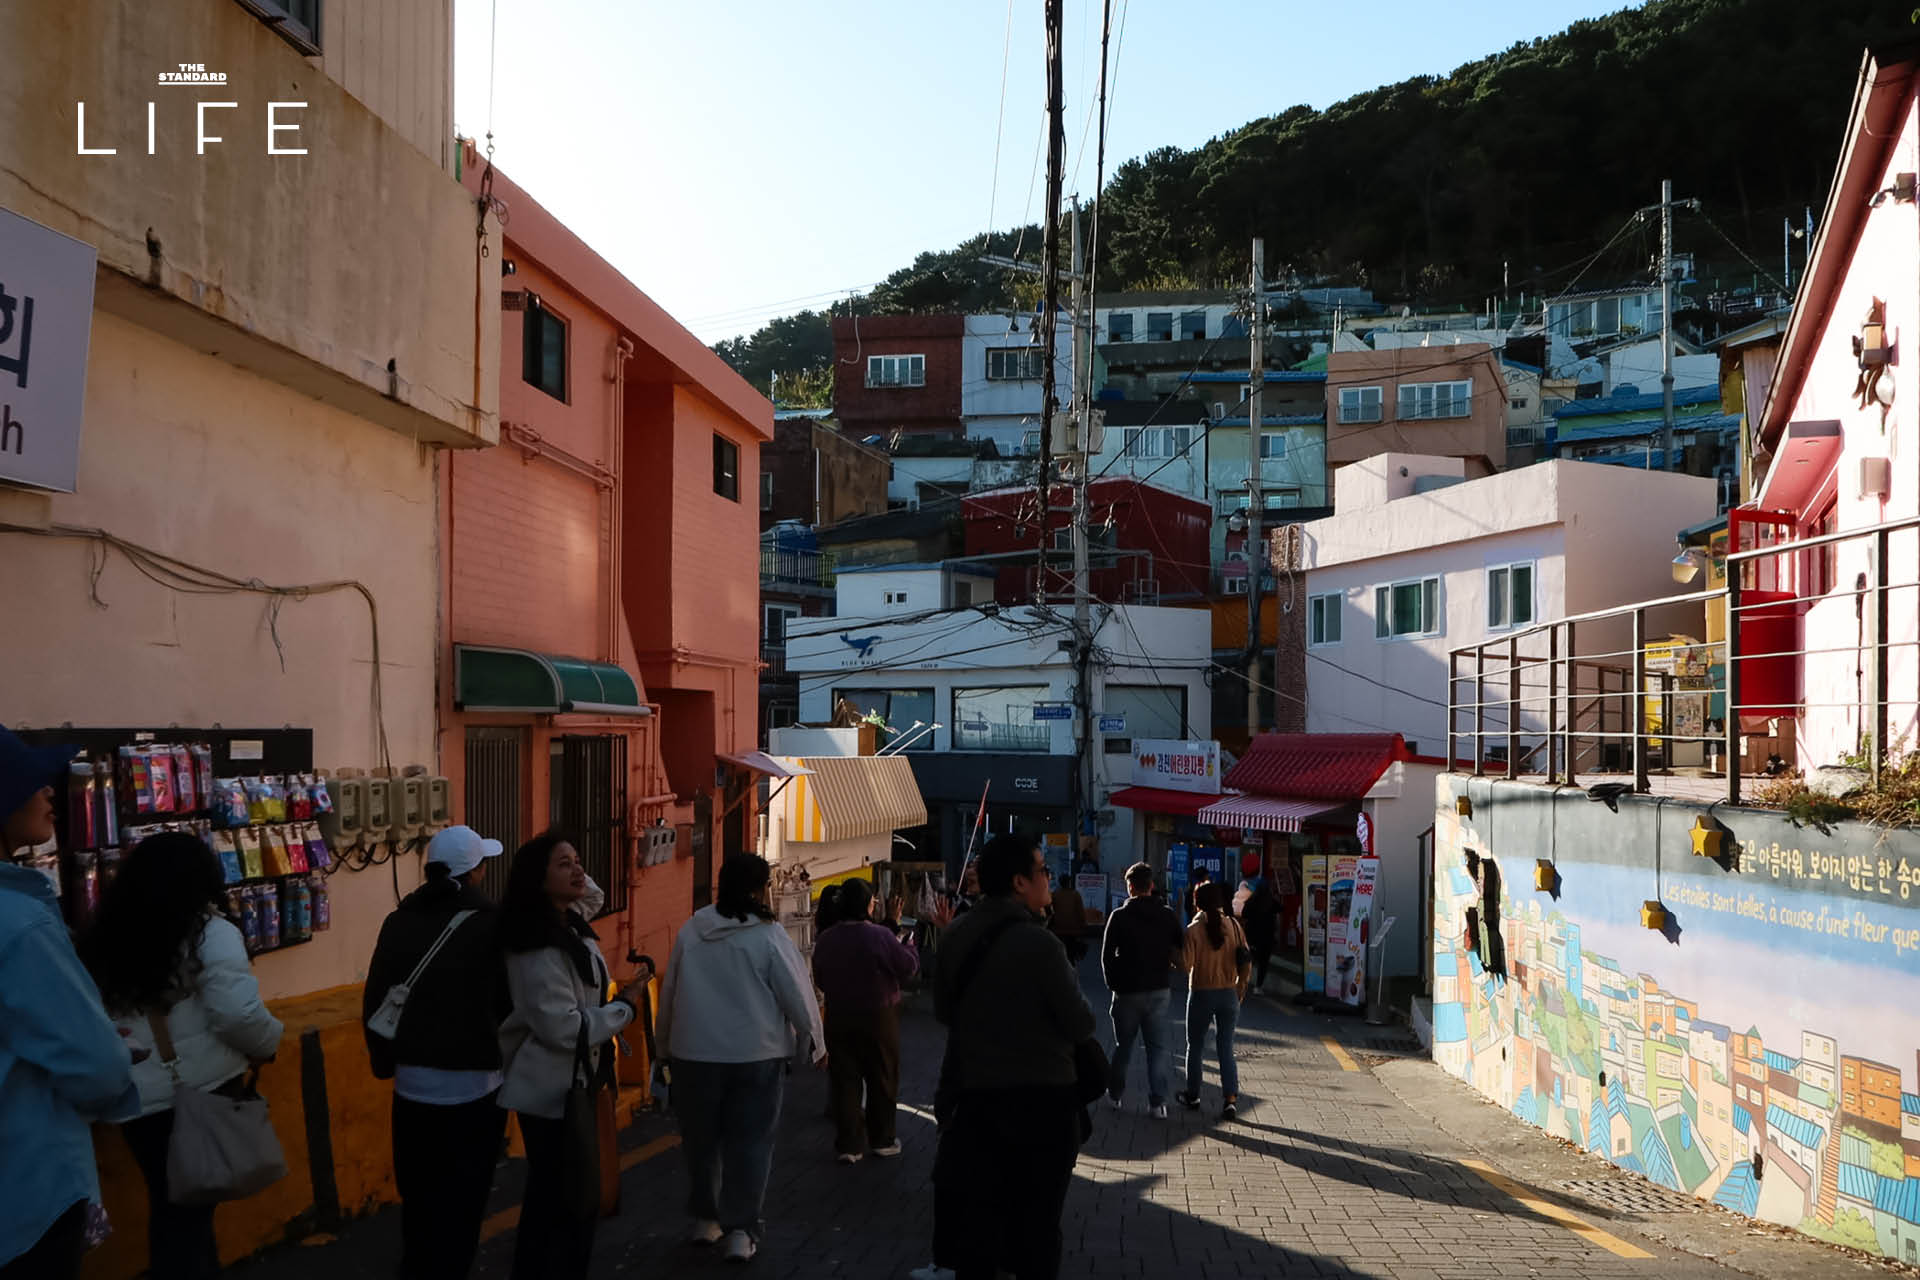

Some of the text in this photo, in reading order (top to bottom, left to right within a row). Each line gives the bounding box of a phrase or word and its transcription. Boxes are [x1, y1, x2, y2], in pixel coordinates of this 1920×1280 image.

[1759, 841, 1807, 880] 아름다워.
[1809, 850, 1845, 882] 보이지
[1847, 855, 1874, 892] 않는
[1878, 856, 1893, 894] 한
[1711, 892, 1736, 913] sont
[1736, 892, 1768, 924] belles,
[1780, 906, 1815, 930] cause
[1816, 904, 1850, 938] d'une
[1853, 910, 1889, 944] fleur
[1892, 927, 1920, 957] que
